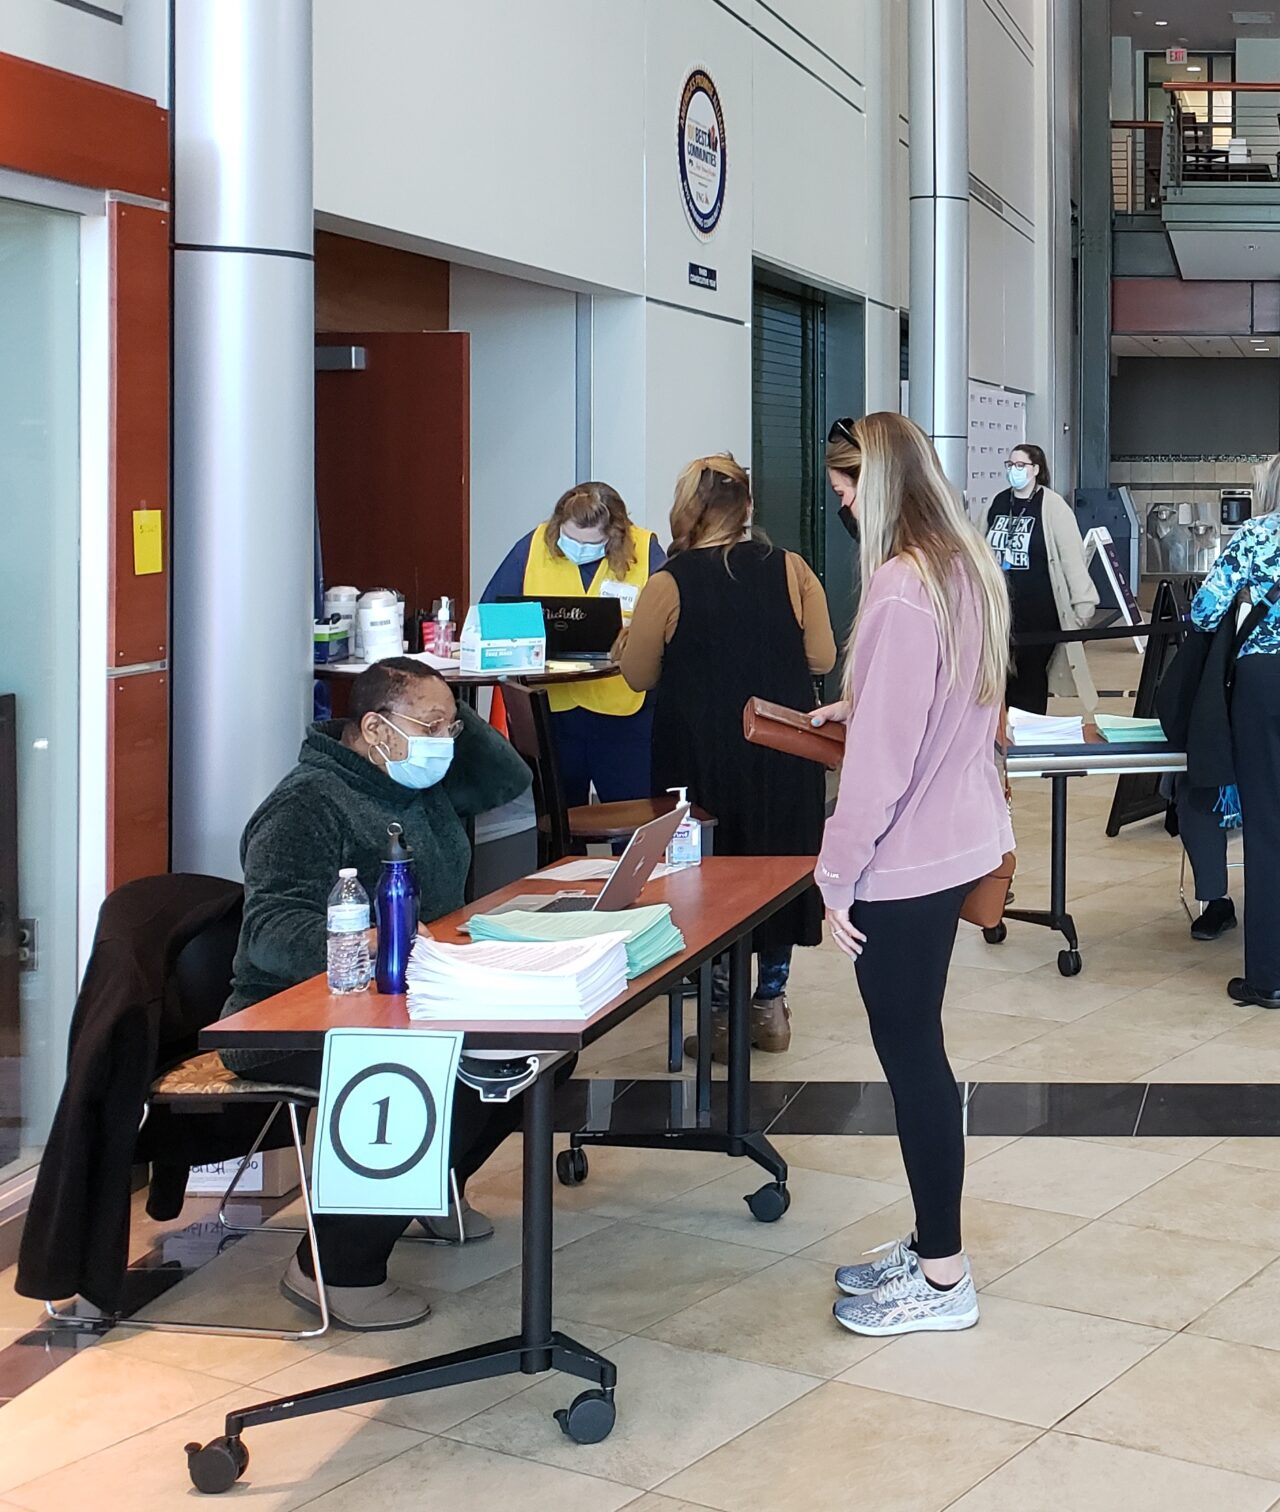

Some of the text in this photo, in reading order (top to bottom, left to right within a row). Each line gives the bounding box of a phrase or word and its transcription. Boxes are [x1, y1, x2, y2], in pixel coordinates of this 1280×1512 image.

[1169, 50, 1184, 62] EXIT
[695, 126, 708, 147] BEST
[687, 141, 717, 168] COMMUNITIES
[990, 532, 1025, 550] LIVES
[995, 550, 1028, 566] ATER
[368, 1095, 393, 1145] 1
